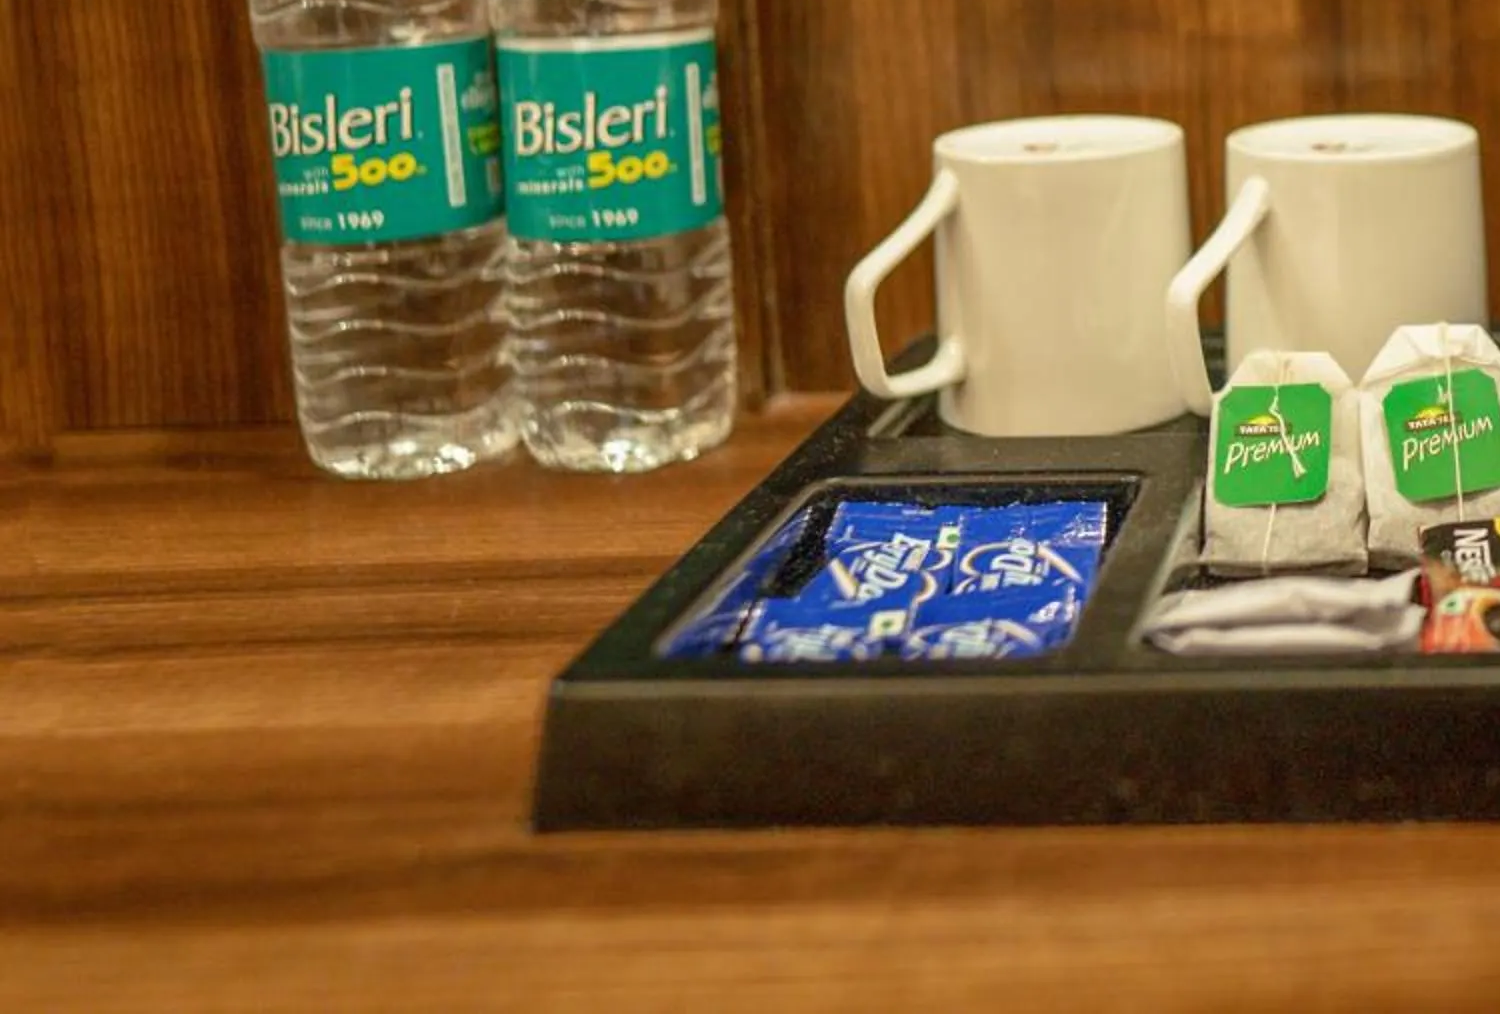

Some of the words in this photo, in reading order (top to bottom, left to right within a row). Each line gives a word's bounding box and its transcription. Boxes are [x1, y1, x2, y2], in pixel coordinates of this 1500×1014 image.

[268, 86, 412, 157] Bisleri
[515, 84, 668, 156] Bisleri
[331, 152, 417, 191] 500
[587, 150, 670, 190] 500
[337, 208, 385, 231] 1969
[592, 206, 640, 229] 1969
